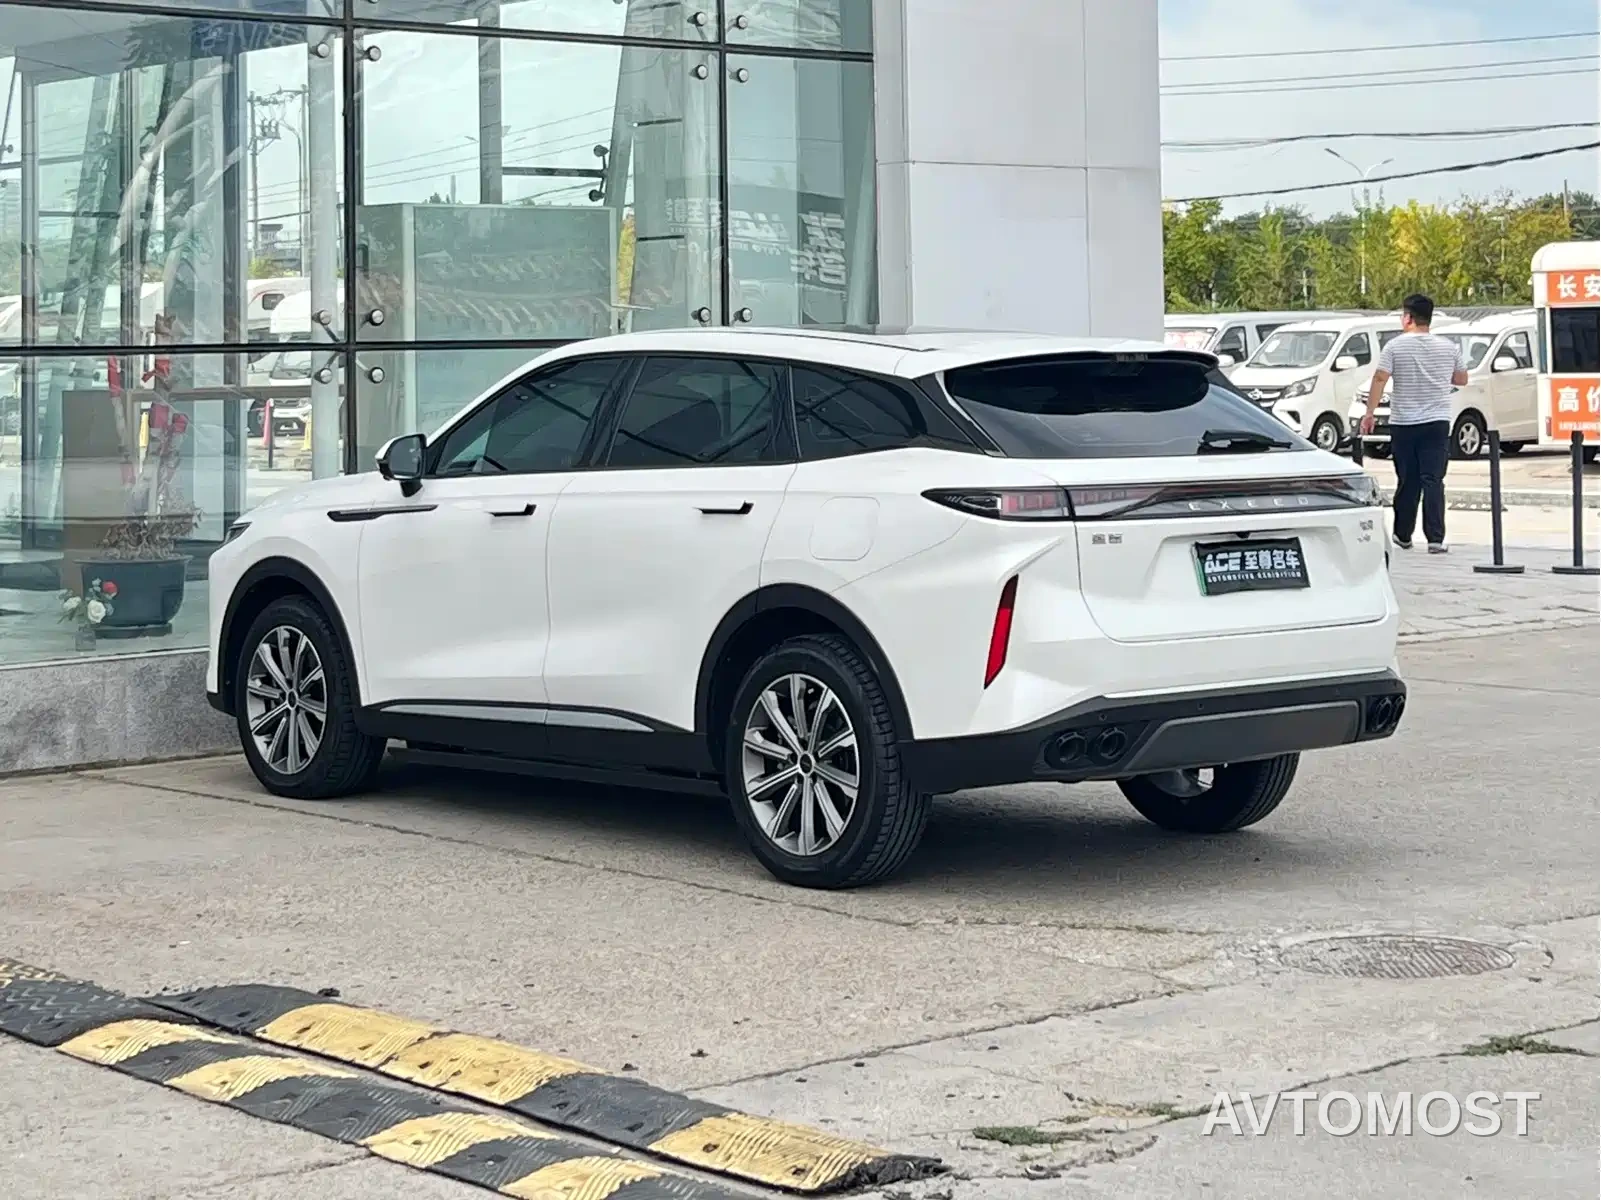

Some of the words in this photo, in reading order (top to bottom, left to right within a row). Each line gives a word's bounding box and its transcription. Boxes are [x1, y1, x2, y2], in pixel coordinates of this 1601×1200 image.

[1557, 274, 1600, 299] 长安
[1188, 496, 1309, 512] EXEED
[1204, 551, 1242, 574] ACE
[1243, 548, 1301, 571] 至尊名车
[1206, 573, 1255, 584] AUTOMOTIVE
